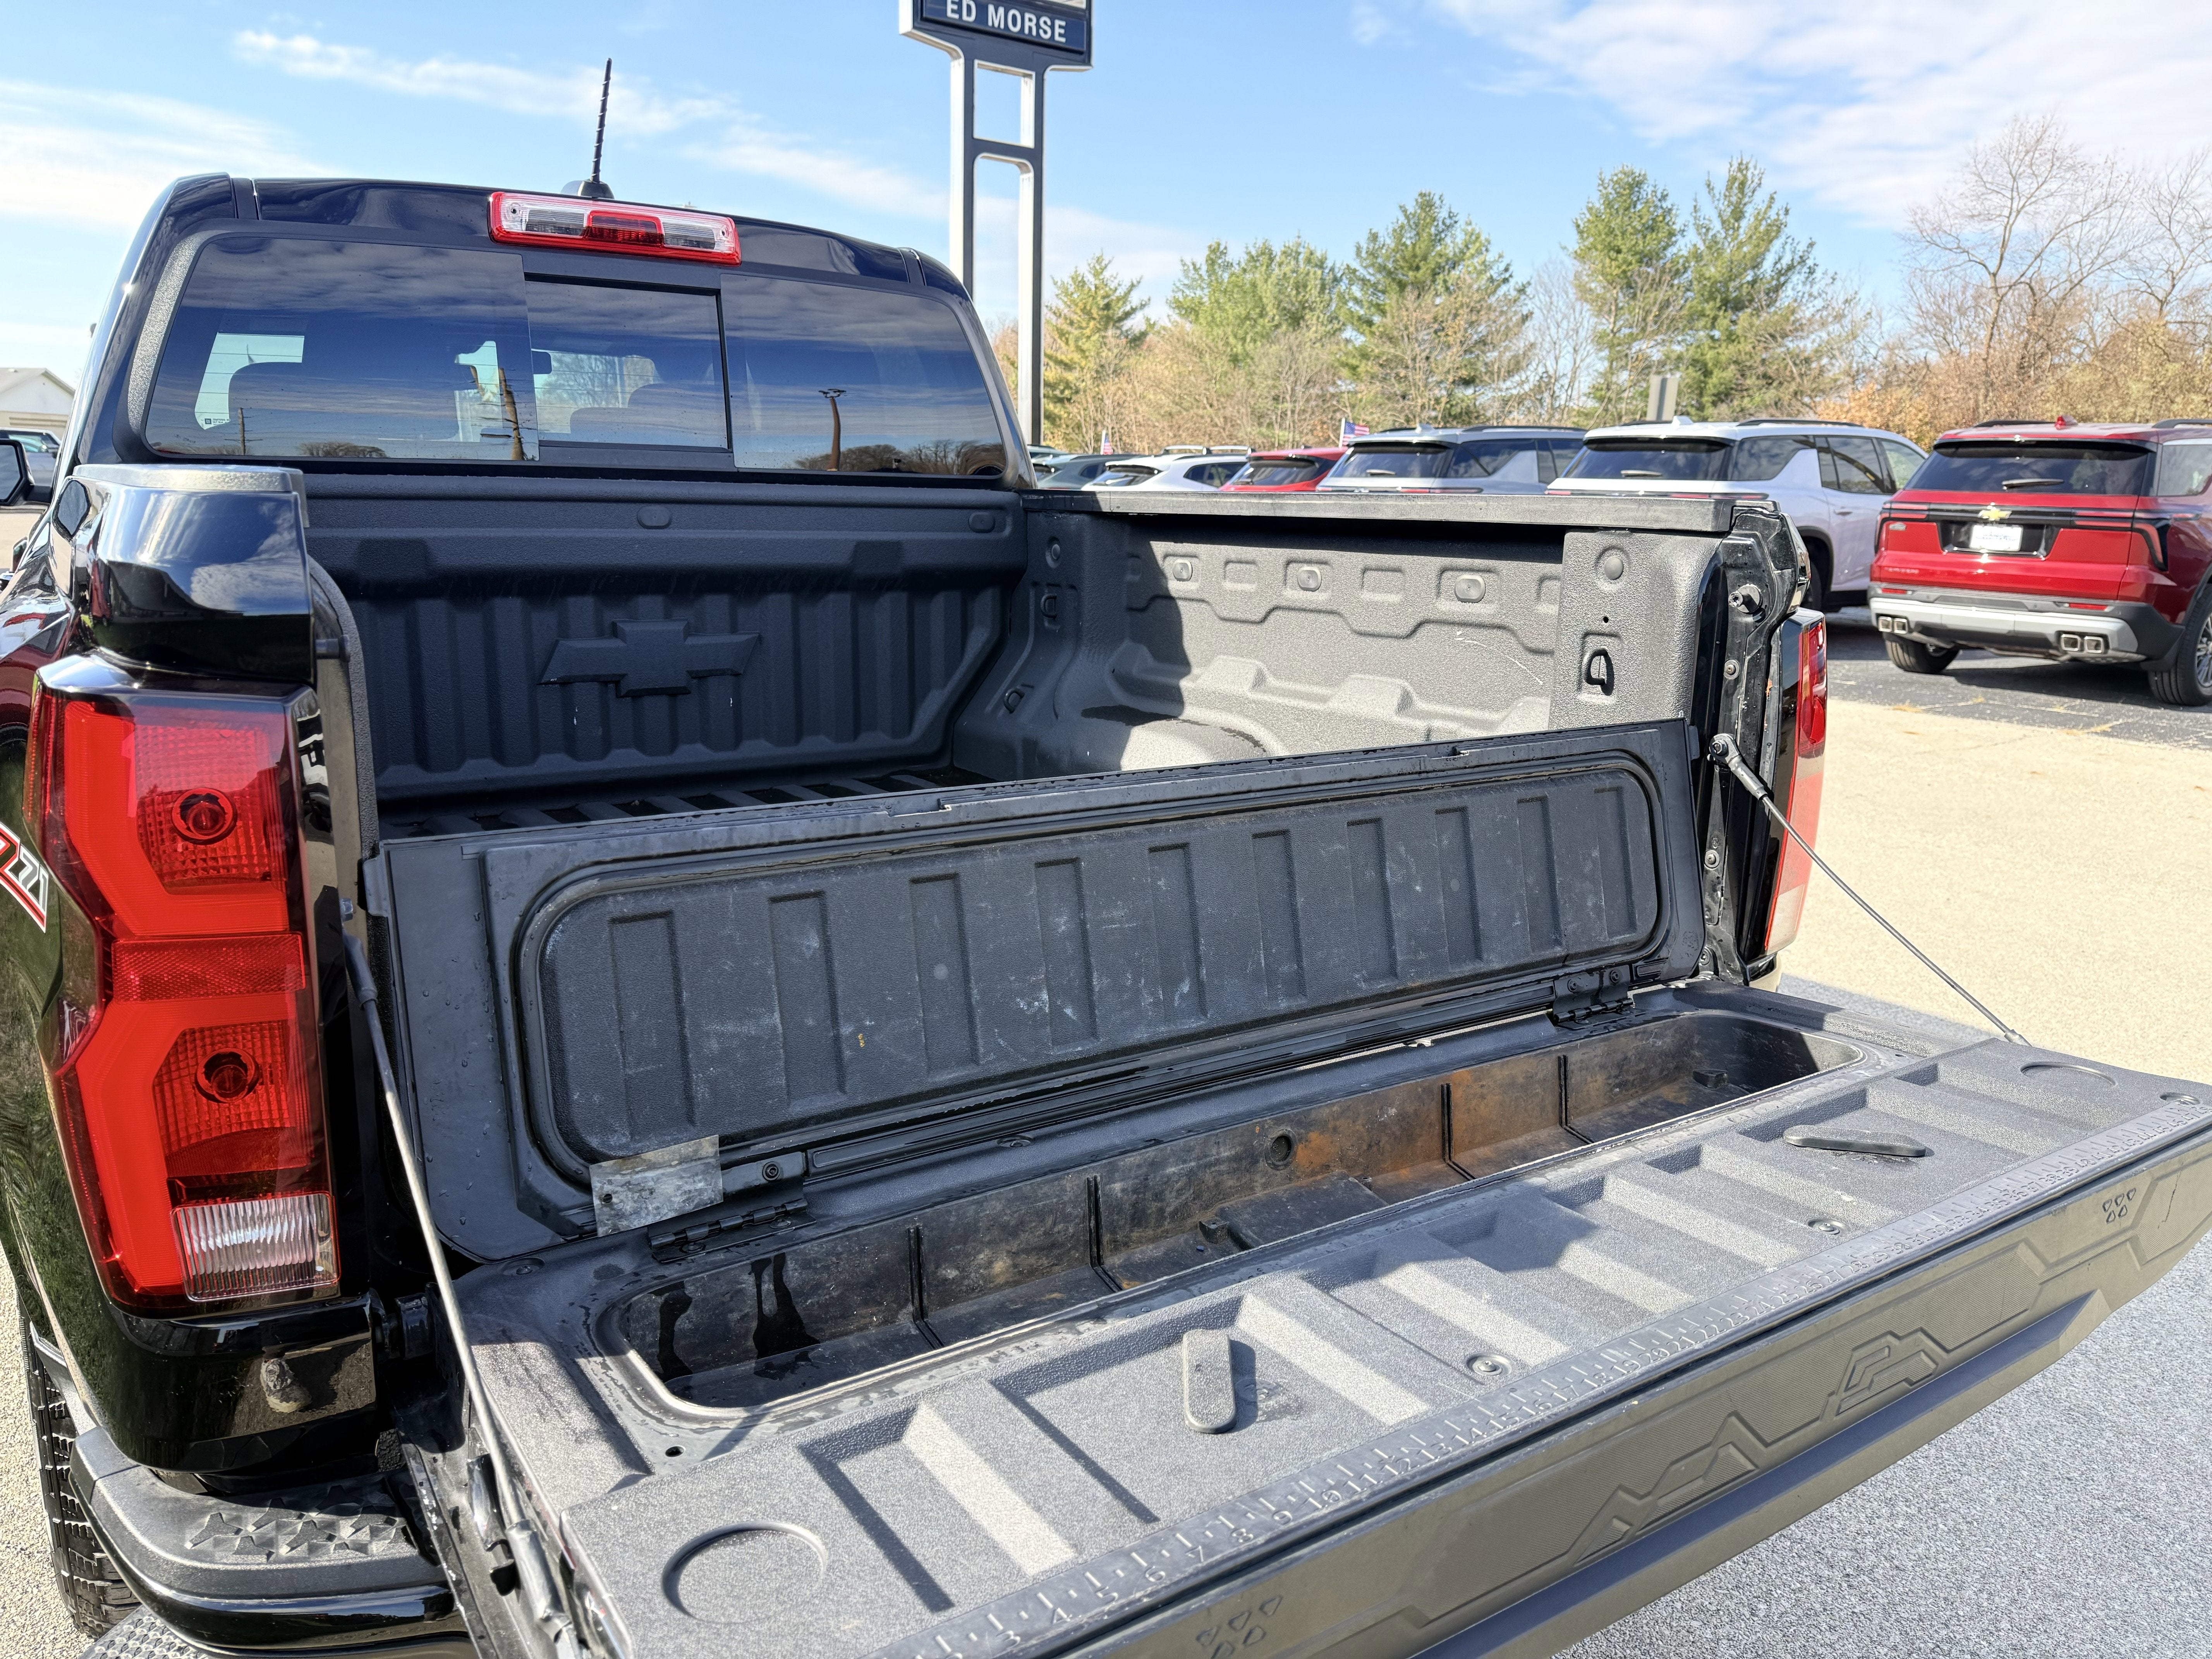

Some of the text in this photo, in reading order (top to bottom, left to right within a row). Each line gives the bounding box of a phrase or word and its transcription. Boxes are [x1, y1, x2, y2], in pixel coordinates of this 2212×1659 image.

[946, 0, 1066, 43] ED MORSE
[996, 1630, 1020, 1648] 3
[1053, 1607, 1072, 1625] 4
[1094, 1586, 1118, 1604] 5
[1145, 1566, 1165, 1582] 6
[1185, 1546, 1204, 1562] 7
[1232, 1528, 1254, 1542] 8
[1273, 1511, 1293, 1526] 9
[1302, 1489, 1342, 1511] 10
[1343, 1474, 1383, 1495] 11
[1380, 1458, 1420, 1477] 12
[1417, 1443, 1452, 1462] 13
[1452, 1428, 1487, 1447] 14
[1486, 1413, 1520, 1431] 15
[1518, 1398, 1552, 1416] 16
[1550, 1385, 1579, 1403] 17
[1581, 1372, 1613, 1389] 18
[1610, 1360, 1641, 1376] 19
[1638, 1348, 1670, 1363] 20
[1666, 1336, 1700, 1351] 21
[1693, 1324, 1726, 1339] 22
[1720, 1313, 1750, 1326] 23
[1745, 1301, 1776, 1316] 24
[1771, 1290, 1799, 1304] 25
[1794, 1280, 1822, 1293] 26
[1818, 1270, 1844, 1283] 27
[1840, 1261, 1869, 1273] 28
[1863, 1252, 1890, 1263] 29
[1884, 1243, 1912, 1254] 30
[1906, 1234, 1934, 1245] 31
[1926, 1224, 1954, 1236] 32
[1946, 1216, 1972, 1227] 33
[1965, 1207, 1992, 1218] 34
[1984, 1198, 2011, 1209] 35
[2002, 1190, 2028, 1201] 36
[2021, 1181, 2044, 1192] 37
[2038, 1174, 2064, 1185] 38
[2056, 1166, 2080, 1176] 39
[2075, 1159, 2097, 1168] 40
[2092, 1152, 2113, 1160] 41
[2167, 1119, 2188, 1127] 46
[2181, 1113, 2200, 1121] 47
